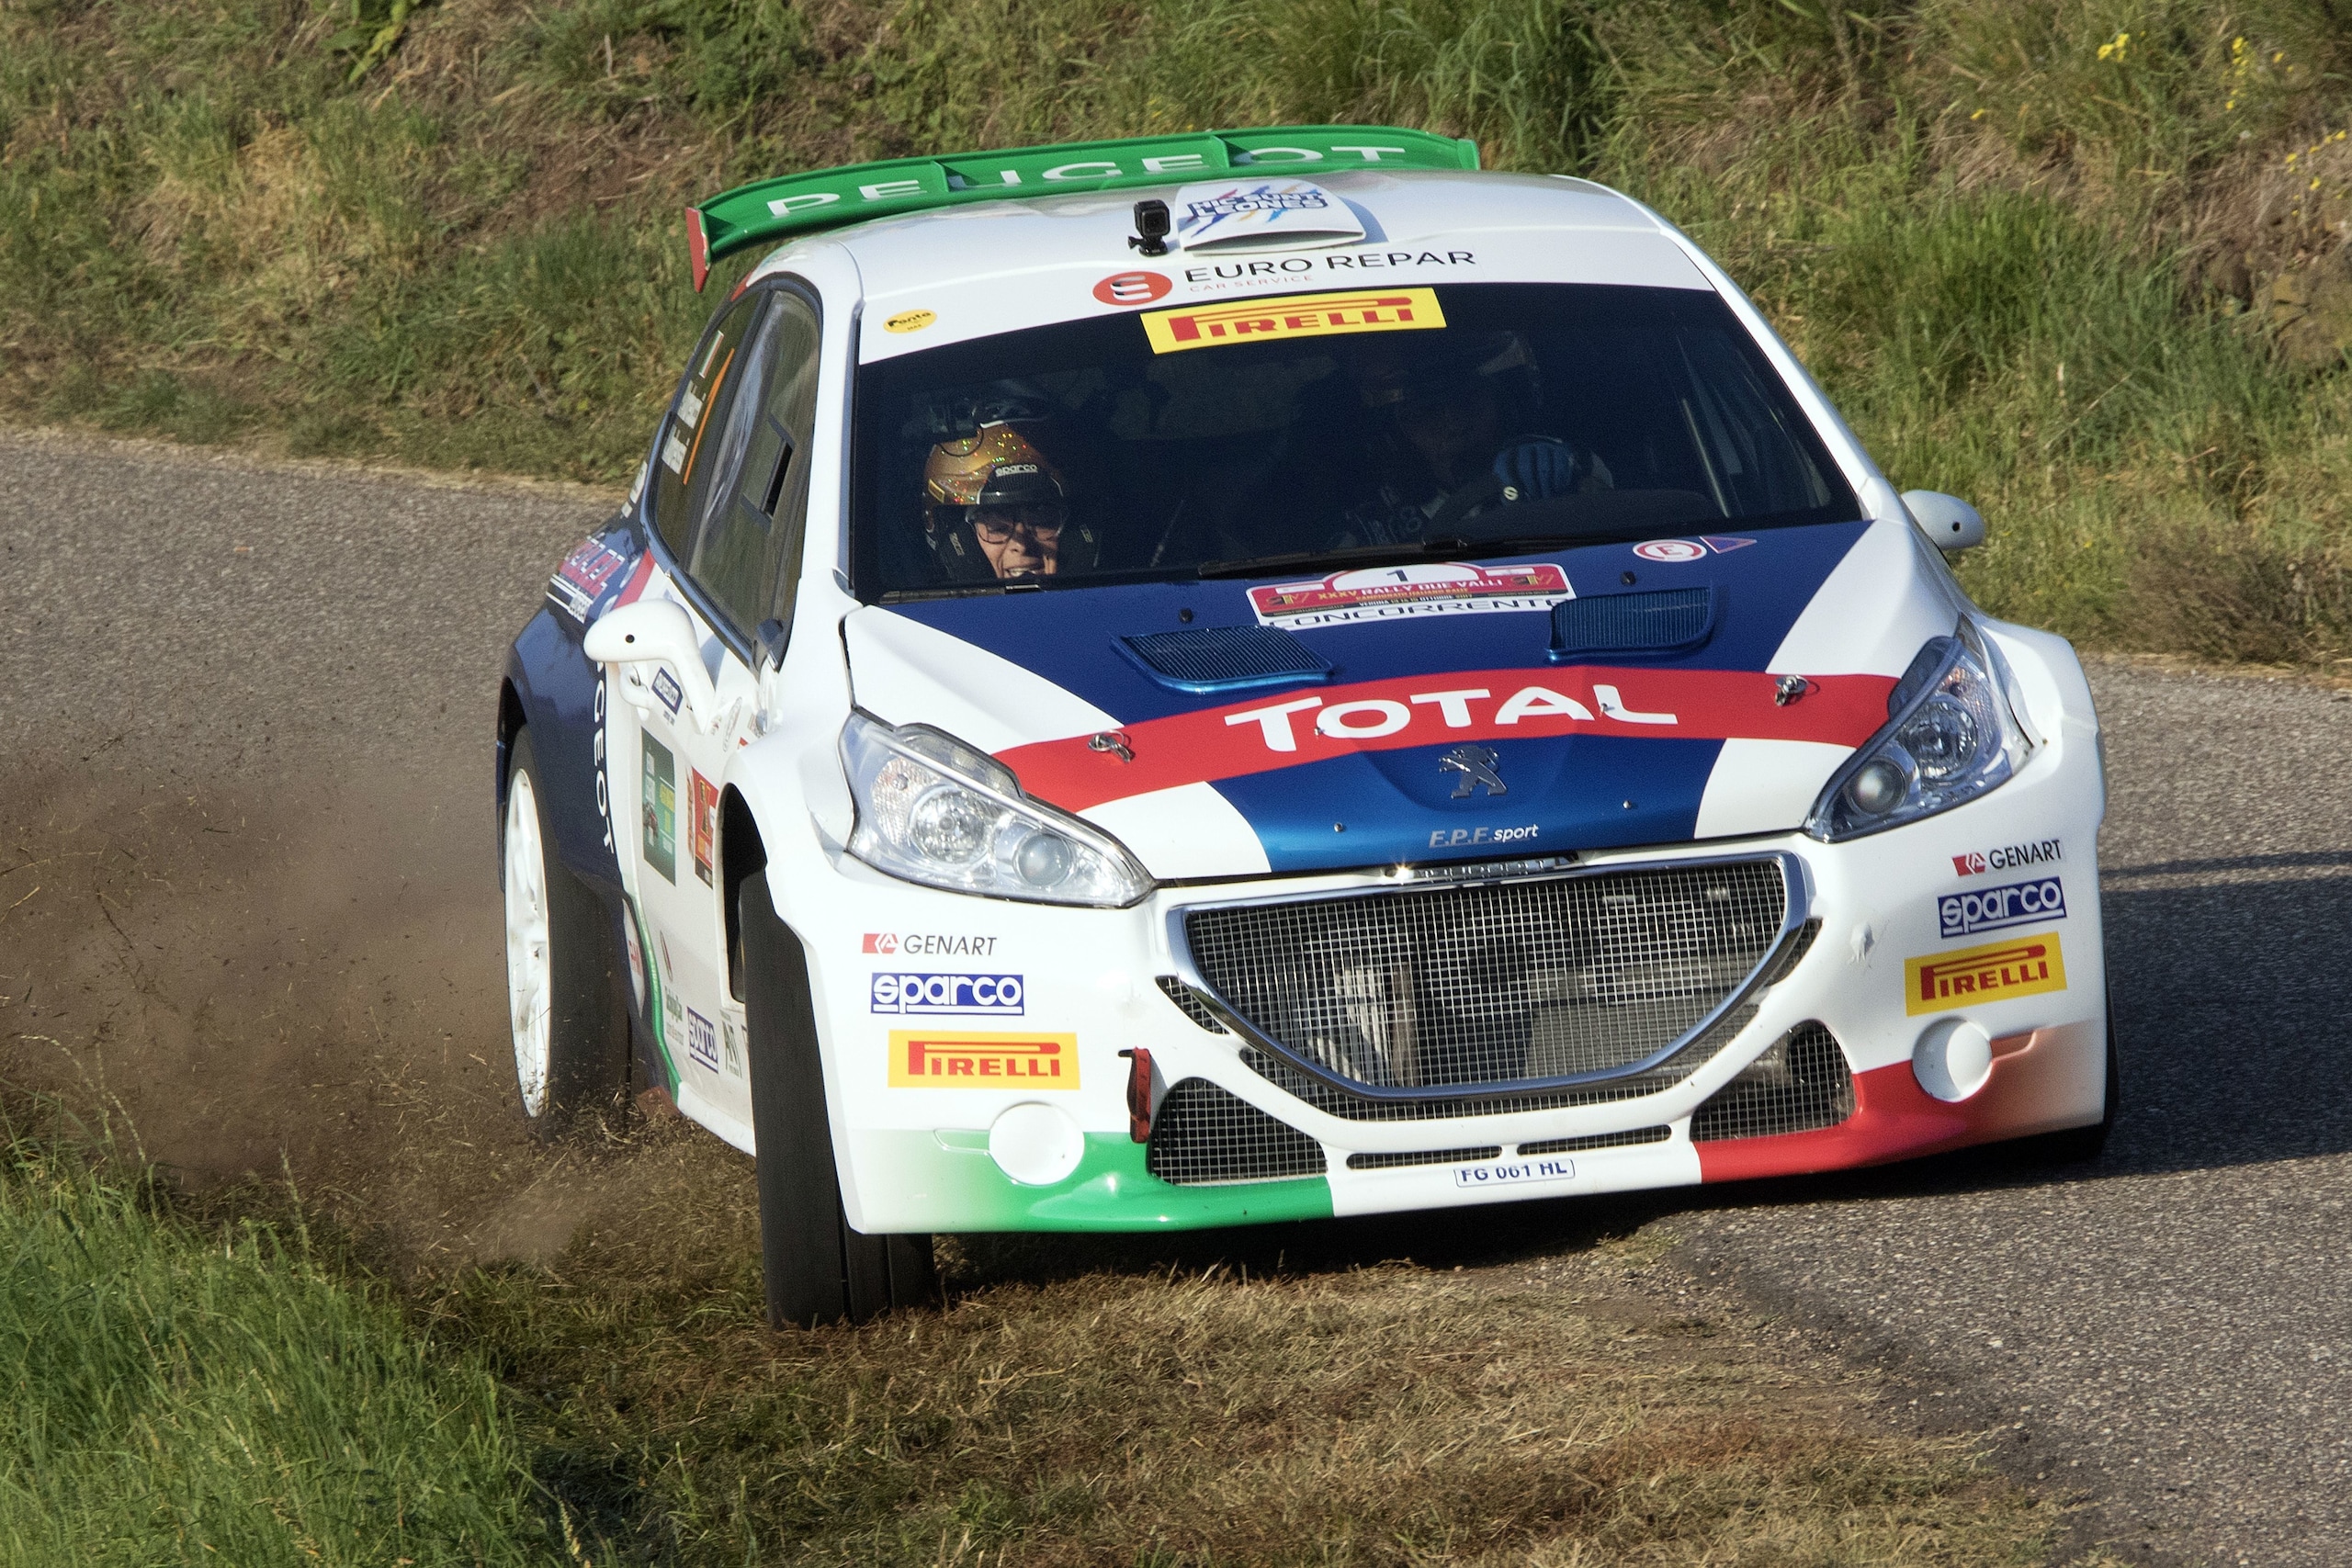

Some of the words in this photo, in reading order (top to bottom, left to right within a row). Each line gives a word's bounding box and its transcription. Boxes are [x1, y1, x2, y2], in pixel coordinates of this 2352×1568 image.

[1192, 197, 1238, 209] HIC
[1242, 192, 1321, 201] SUNT
[1196, 199, 1327, 218] LEONES
[1183, 258, 1314, 283] EURO
[1326, 251, 1477, 269] REPAR
[1189, 282, 1227, 292] CAR
[1234, 275, 1315, 288] SERVICE
[1168, 297, 1414, 343] PIRELLI
[1317, 590, 1358, 601] XXXV
[1361, 584, 1413, 596] RALLY
[1418, 581, 1453, 591] DUE
[1456, 579, 1503, 588] VALLI
[1386, 569, 1409, 583] 1
[1224, 684, 1679, 752] TOTAL
[1989, 839, 2063, 870] GENART
[1940, 880, 2064, 933] sparco
[904, 934, 997, 956] GENART
[1919, 944, 2050, 1001] PIRELLI
[873, 975, 1023, 1014] sparco
[908, 1040, 1061, 1077] PIRELLI
[1461, 1168, 1488, 1182] FG
[1496, 1164, 1532, 1180] 061
[1539, 1161, 1567, 1177] HL
